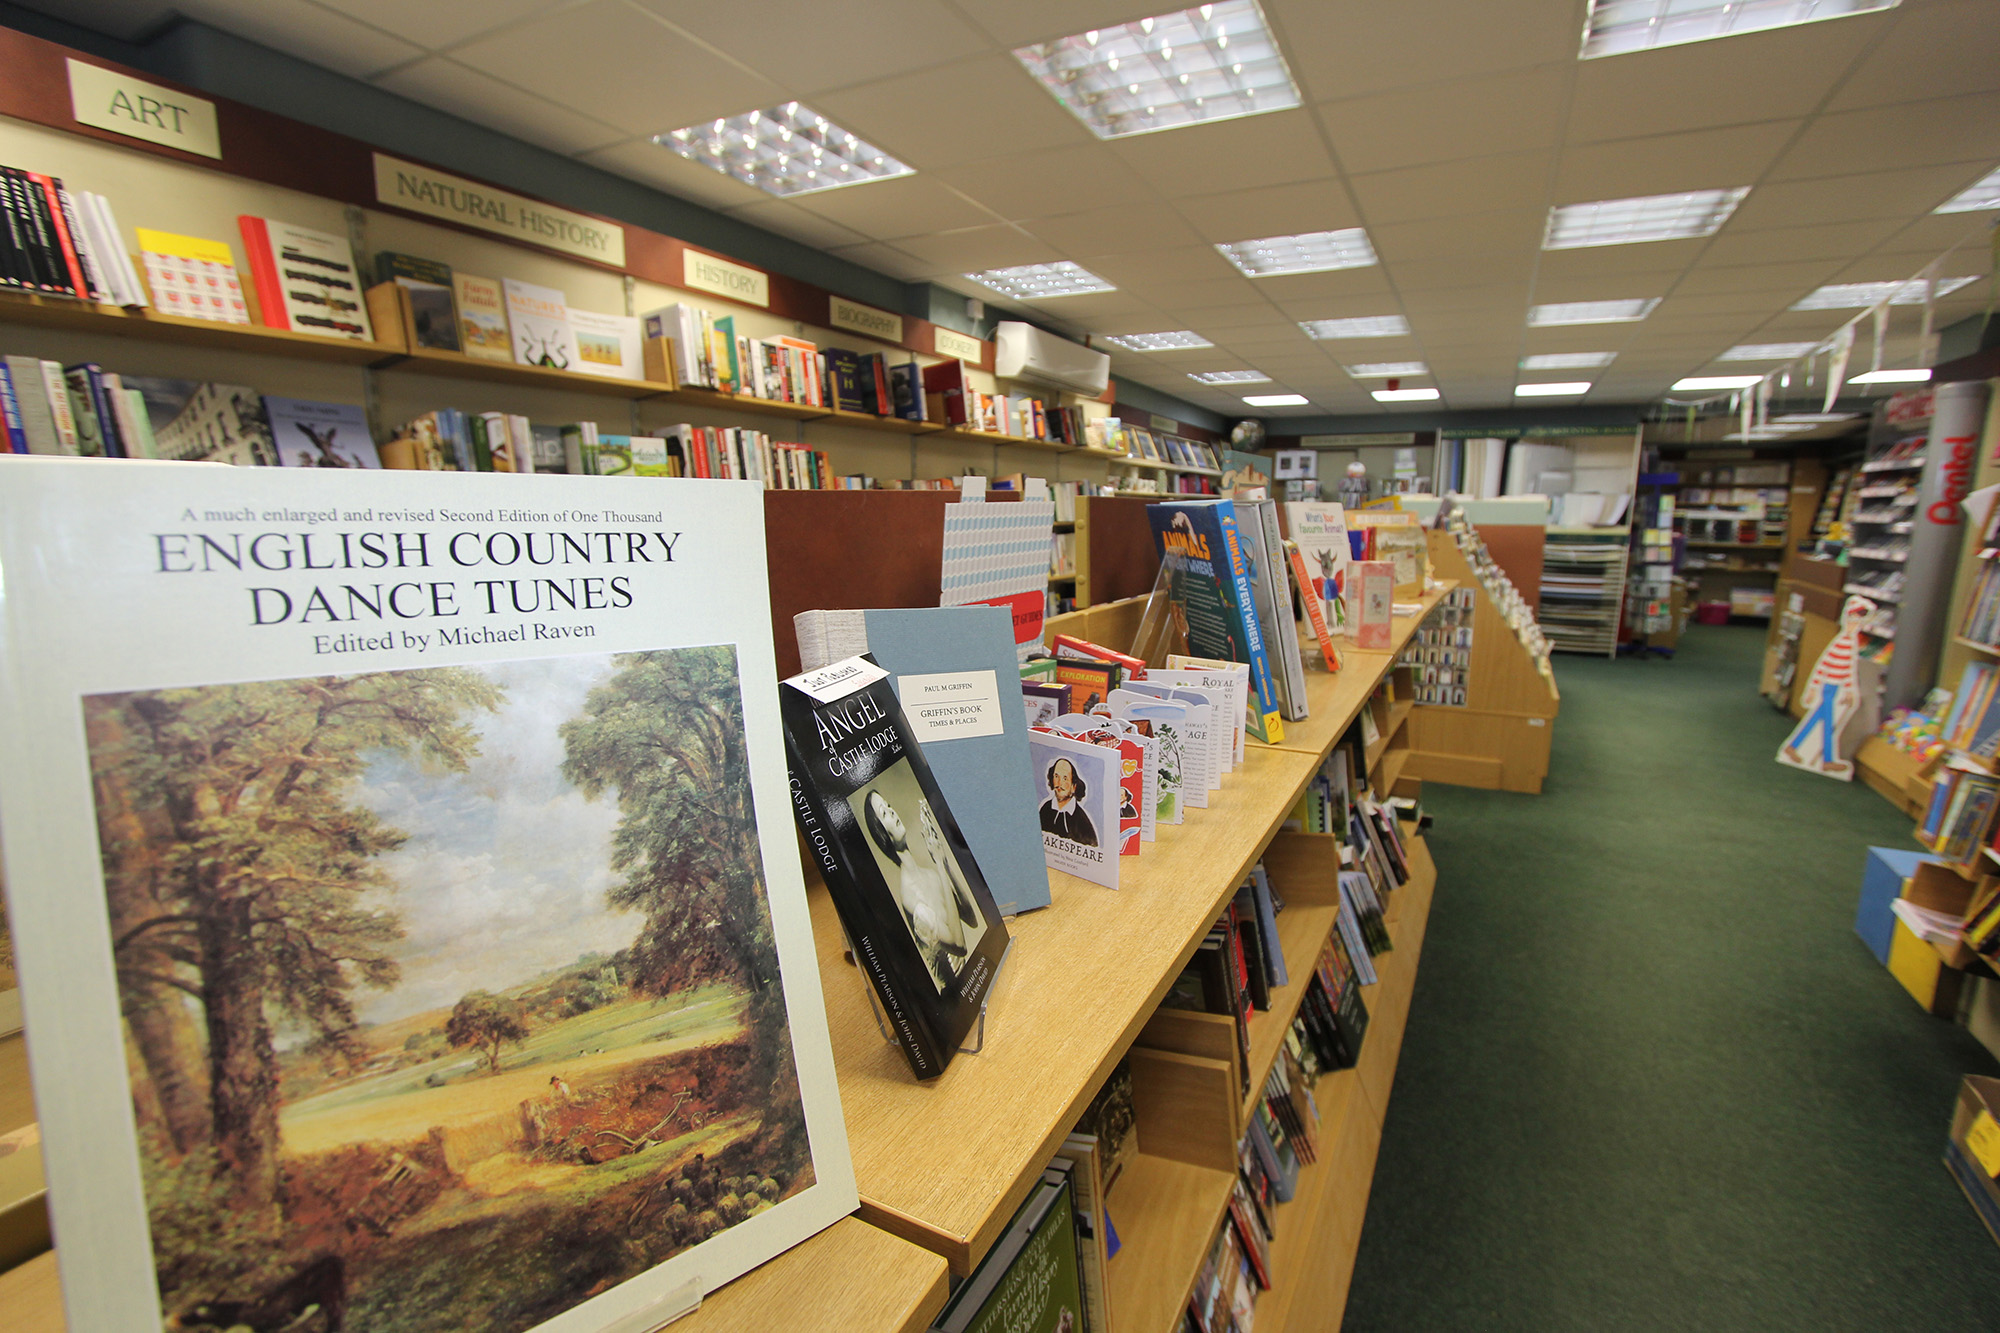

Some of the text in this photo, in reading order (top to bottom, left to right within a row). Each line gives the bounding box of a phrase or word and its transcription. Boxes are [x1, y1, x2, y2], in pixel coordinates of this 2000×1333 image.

[109, 89, 189, 134] ART
[396, 171, 610, 251] NATURAL HISTORY
[696, 261, 759, 295] HISTORY
[837, 304, 897, 334] BIOGRAPHY
[1926, 433, 1979, 526] Pentel
[181, 506, 664, 526] A much enlarged and revised Second Edition of One Thousand
[154, 529, 683, 575] ENGLISH COUNTRY
[1162, 531, 1211, 561] ANIMALS
[247, 575, 635, 627] DANCE TUNES
[1225, 529, 1262, 652] ANIMALS EVERYWHERE
[1020, 610, 1043, 624] GUIDES
[313, 621, 597, 656] Edited by Michael Raven
[924, 685, 941, 693] PAUL
[948, 682, 973, 691] GRIFFIN
[1060, 671, 1106, 683] EXPLORATION
[1202, 676, 1234, 688] ROYAL
[812, 690, 887, 752] ANGEL
[920, 704, 982, 719] GRIFFIN'S BOOK
[928, 718, 949, 728] TIMES
[955, 716, 978, 726] PLACES
[828, 725, 899, 777] CASTLE LODGE
[1185, 729, 1208, 740] AGE
[789, 778, 838, 873] CASTLE LODGE
[1041, 835, 1104, 863] AKESPEARE
[861, 935, 927, 1070] WILLIAM PEARSON & JOHN DAVID
